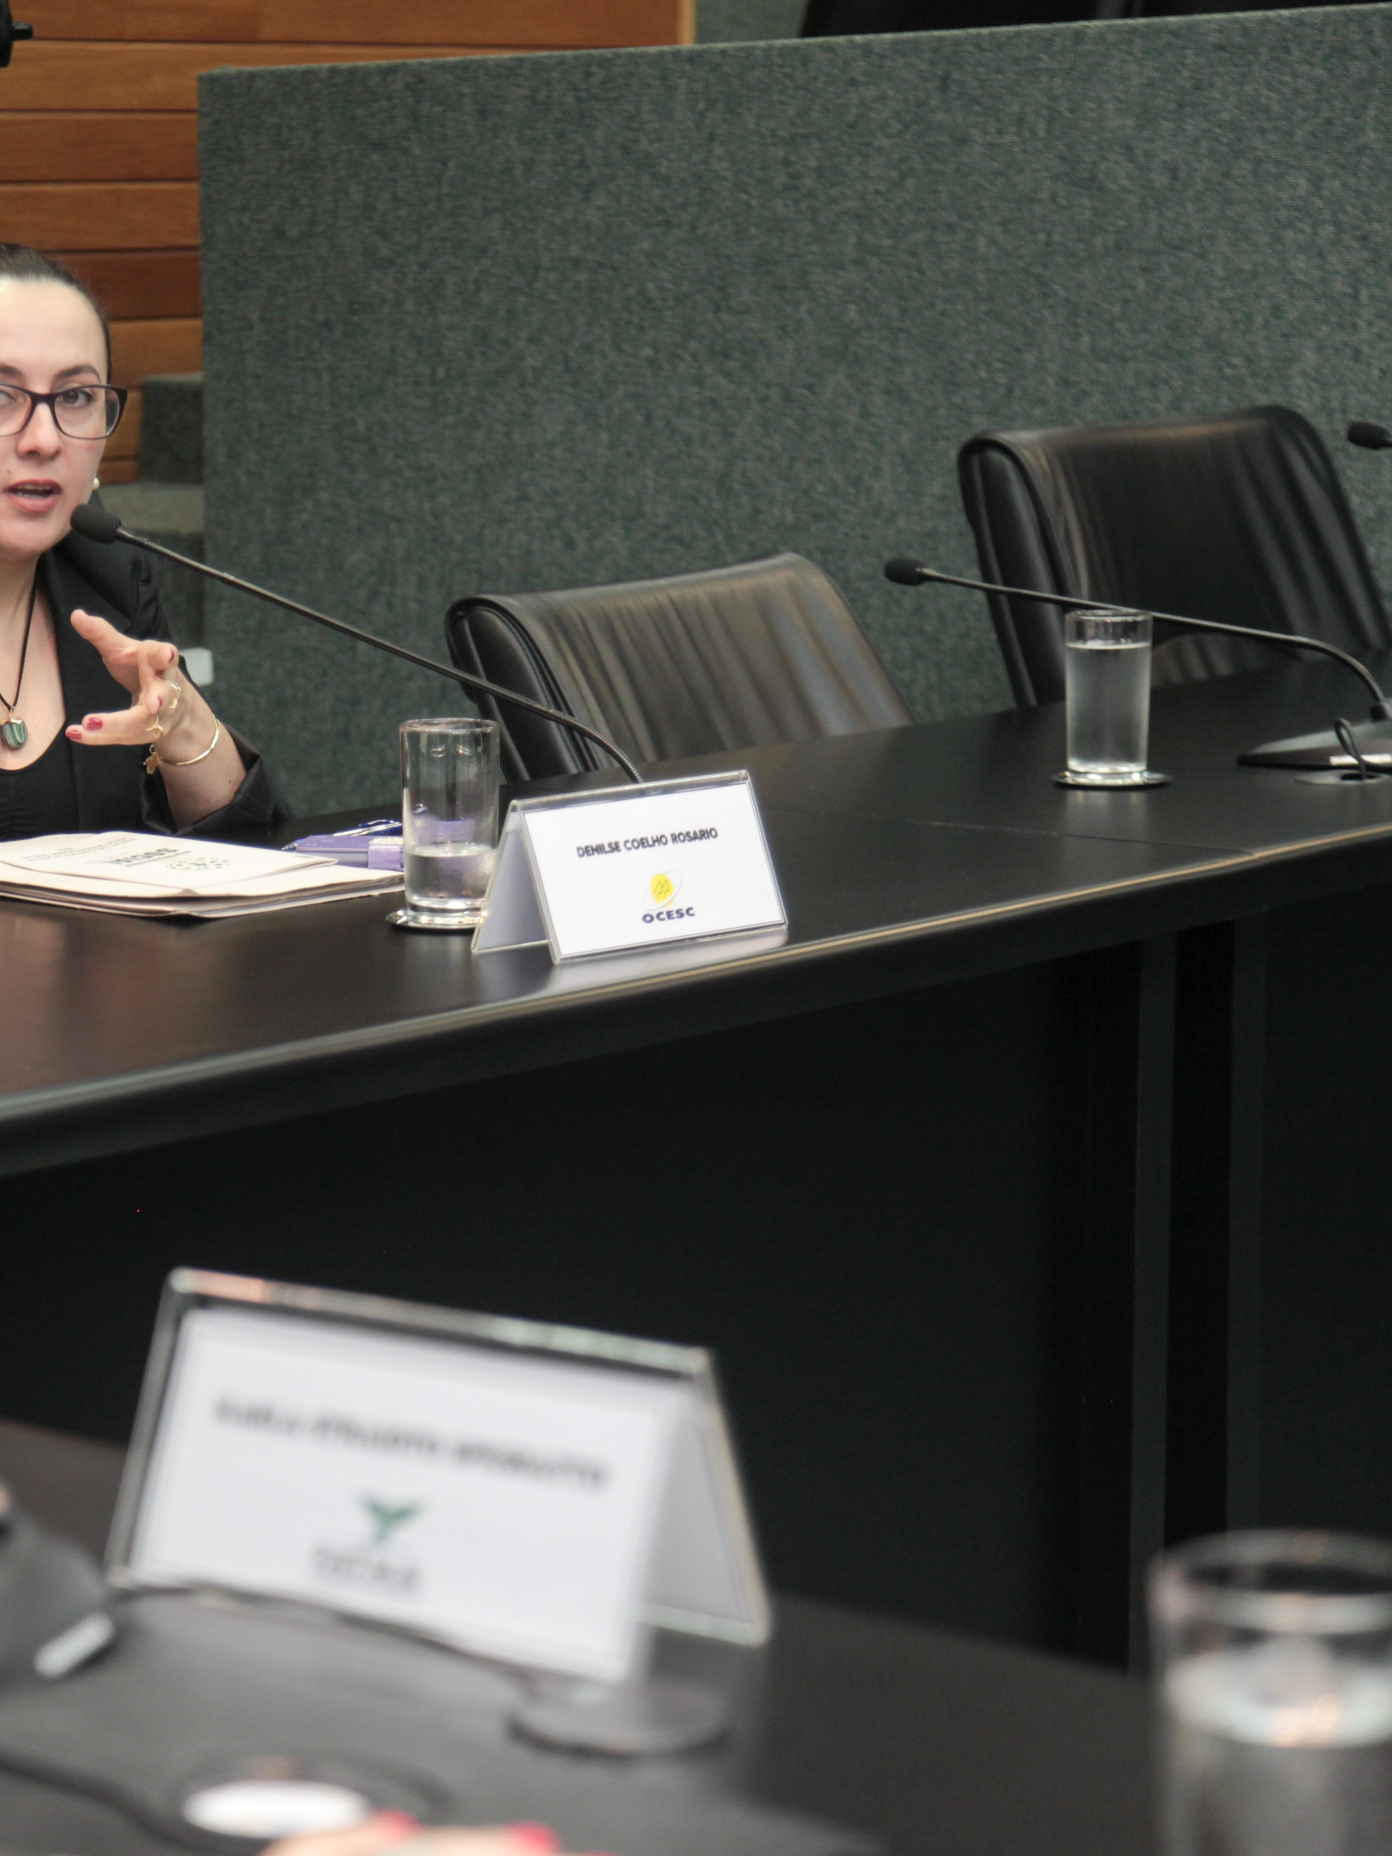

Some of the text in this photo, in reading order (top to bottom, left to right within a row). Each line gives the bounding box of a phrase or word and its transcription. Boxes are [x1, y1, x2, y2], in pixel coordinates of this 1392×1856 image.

[623, 835, 668, 852] COELHO
[671, 827, 718, 845] ROSARIO
[641, 907, 696, 924] OCESC
